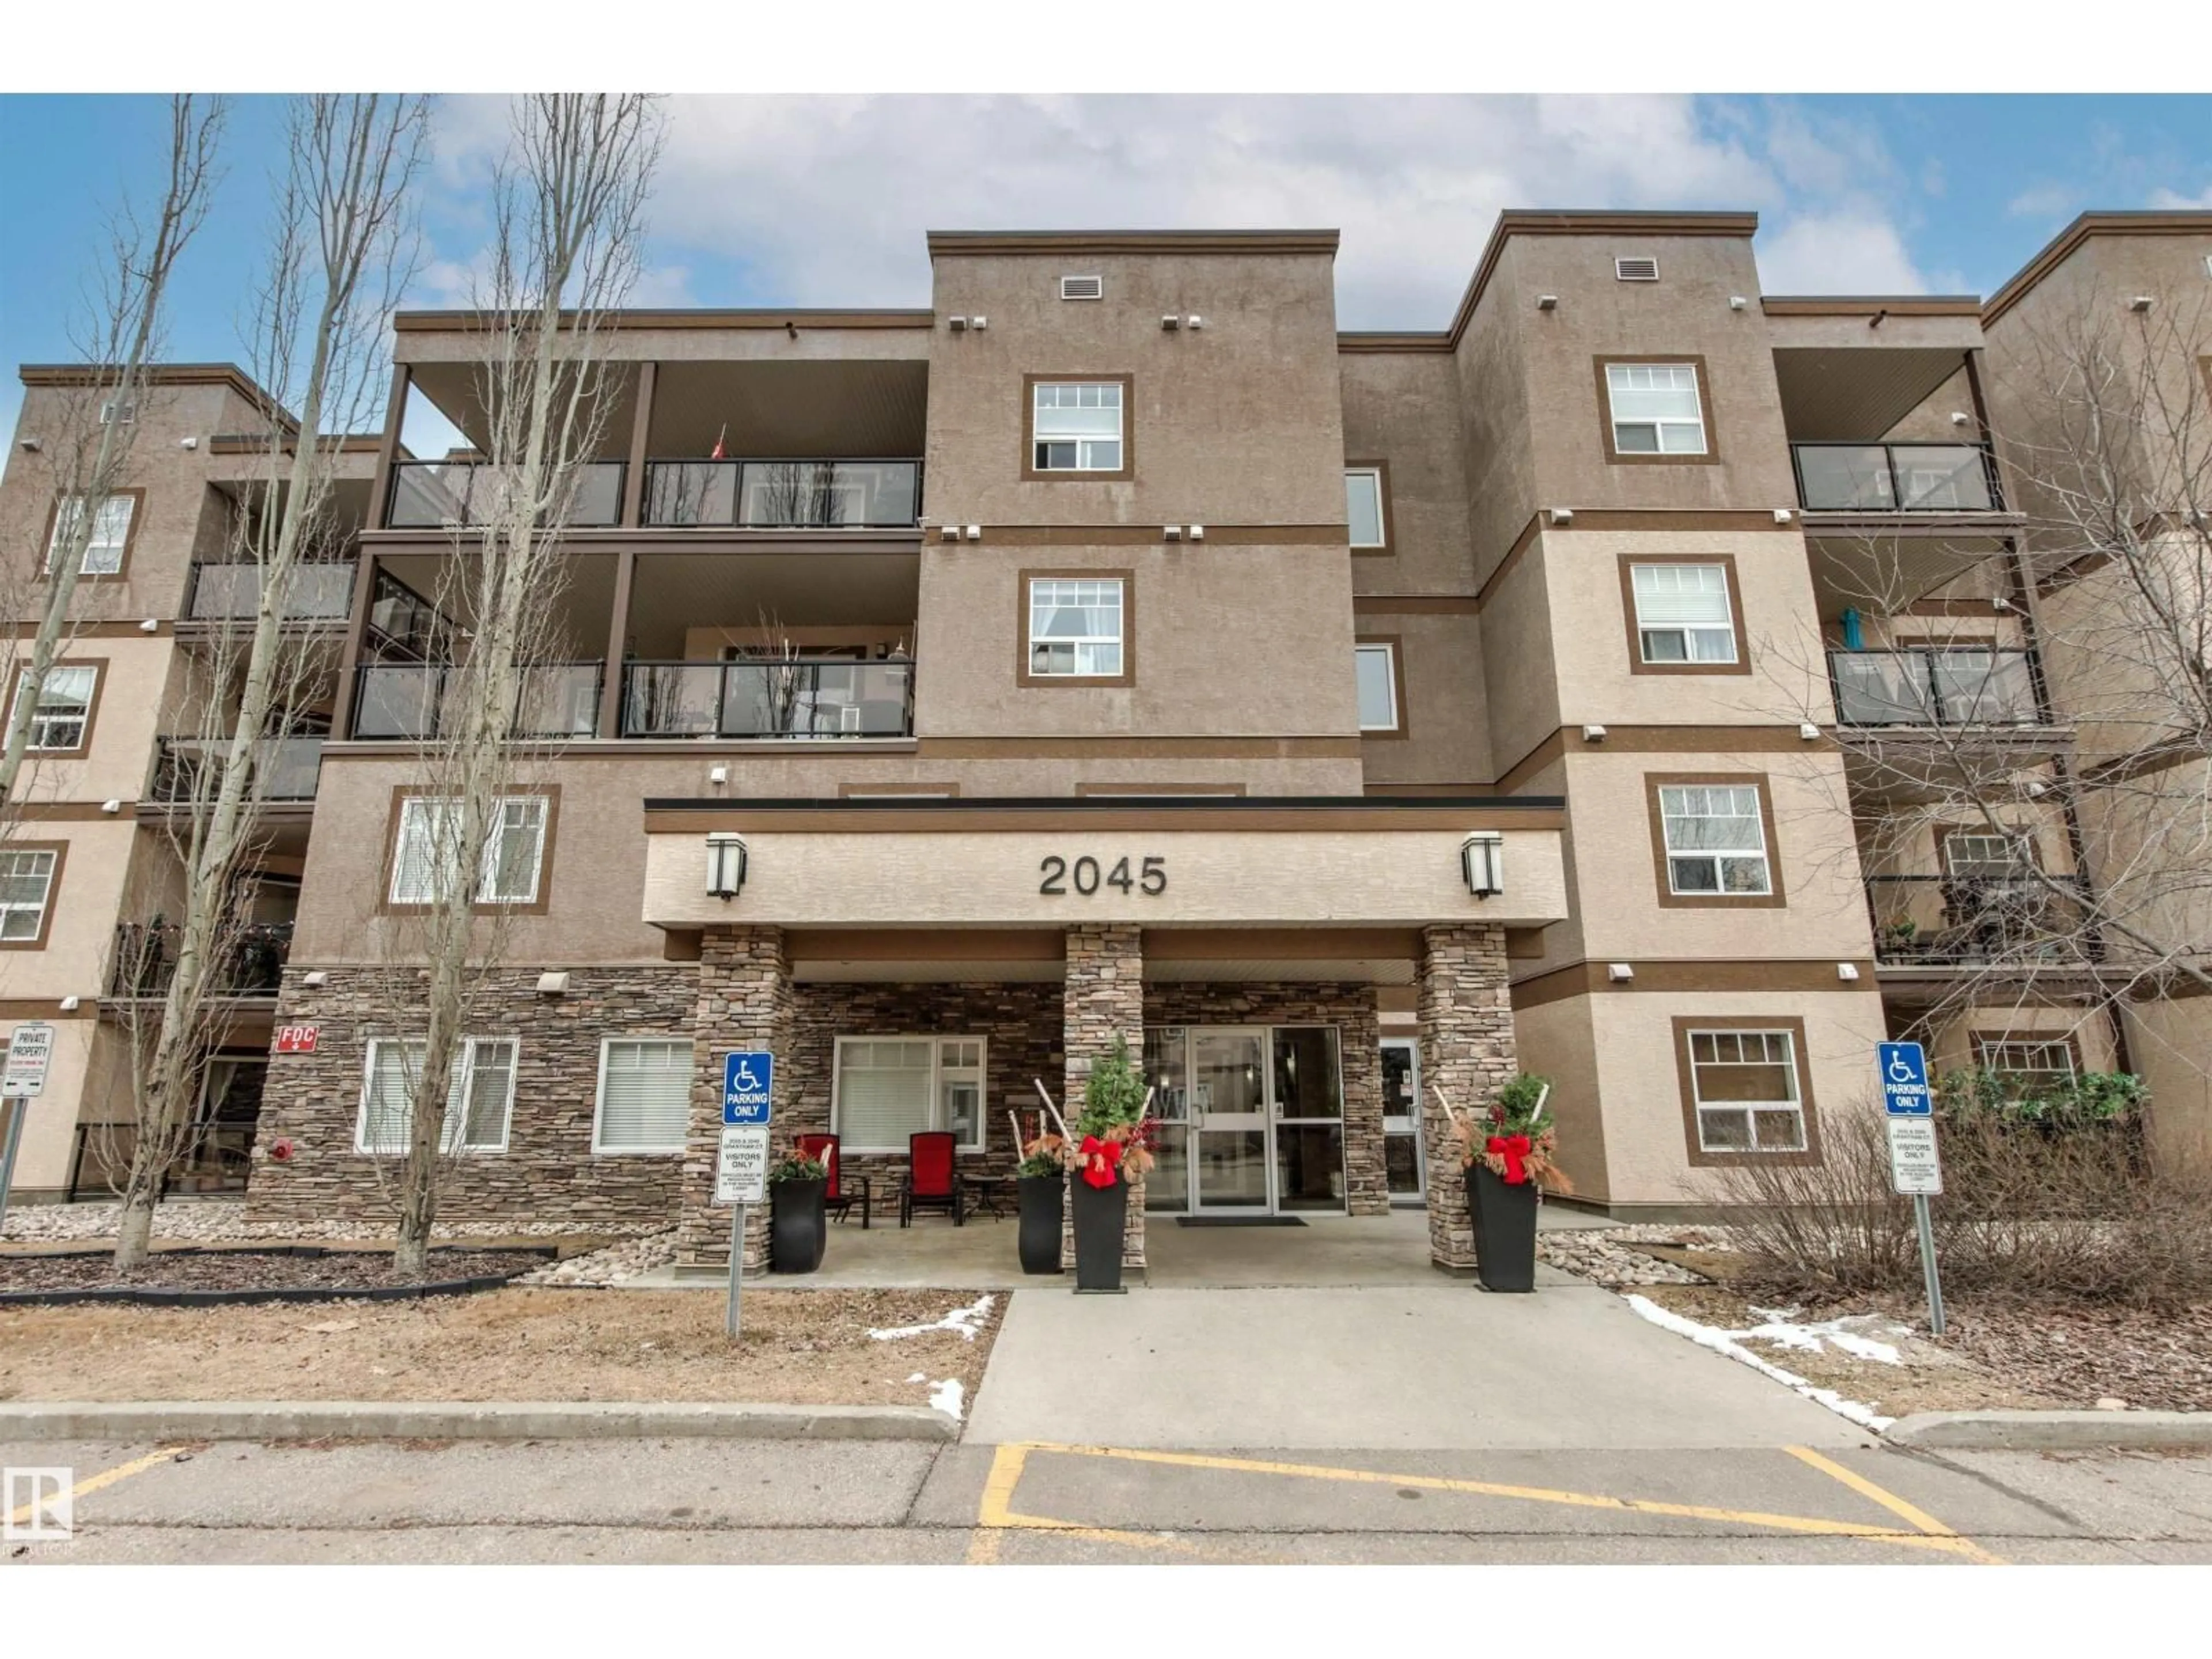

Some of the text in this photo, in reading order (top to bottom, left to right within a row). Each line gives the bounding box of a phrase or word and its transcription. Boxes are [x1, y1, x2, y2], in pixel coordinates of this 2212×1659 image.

[1040, 855, 1167, 896] 2045
[18, 1033, 47, 1043] PRIVATE
[282, 1028, 315, 1042] FDC
[12, 1046, 47, 1056] PROPERTY
[1886, 1084, 1925, 1094] PARKING
[727, 1093, 768, 1104] PARKING
[1895, 1096, 1919, 1107] ONLY
[734, 1105, 759, 1117] ONLY
[725, 1153, 761, 1161] VISITORS
